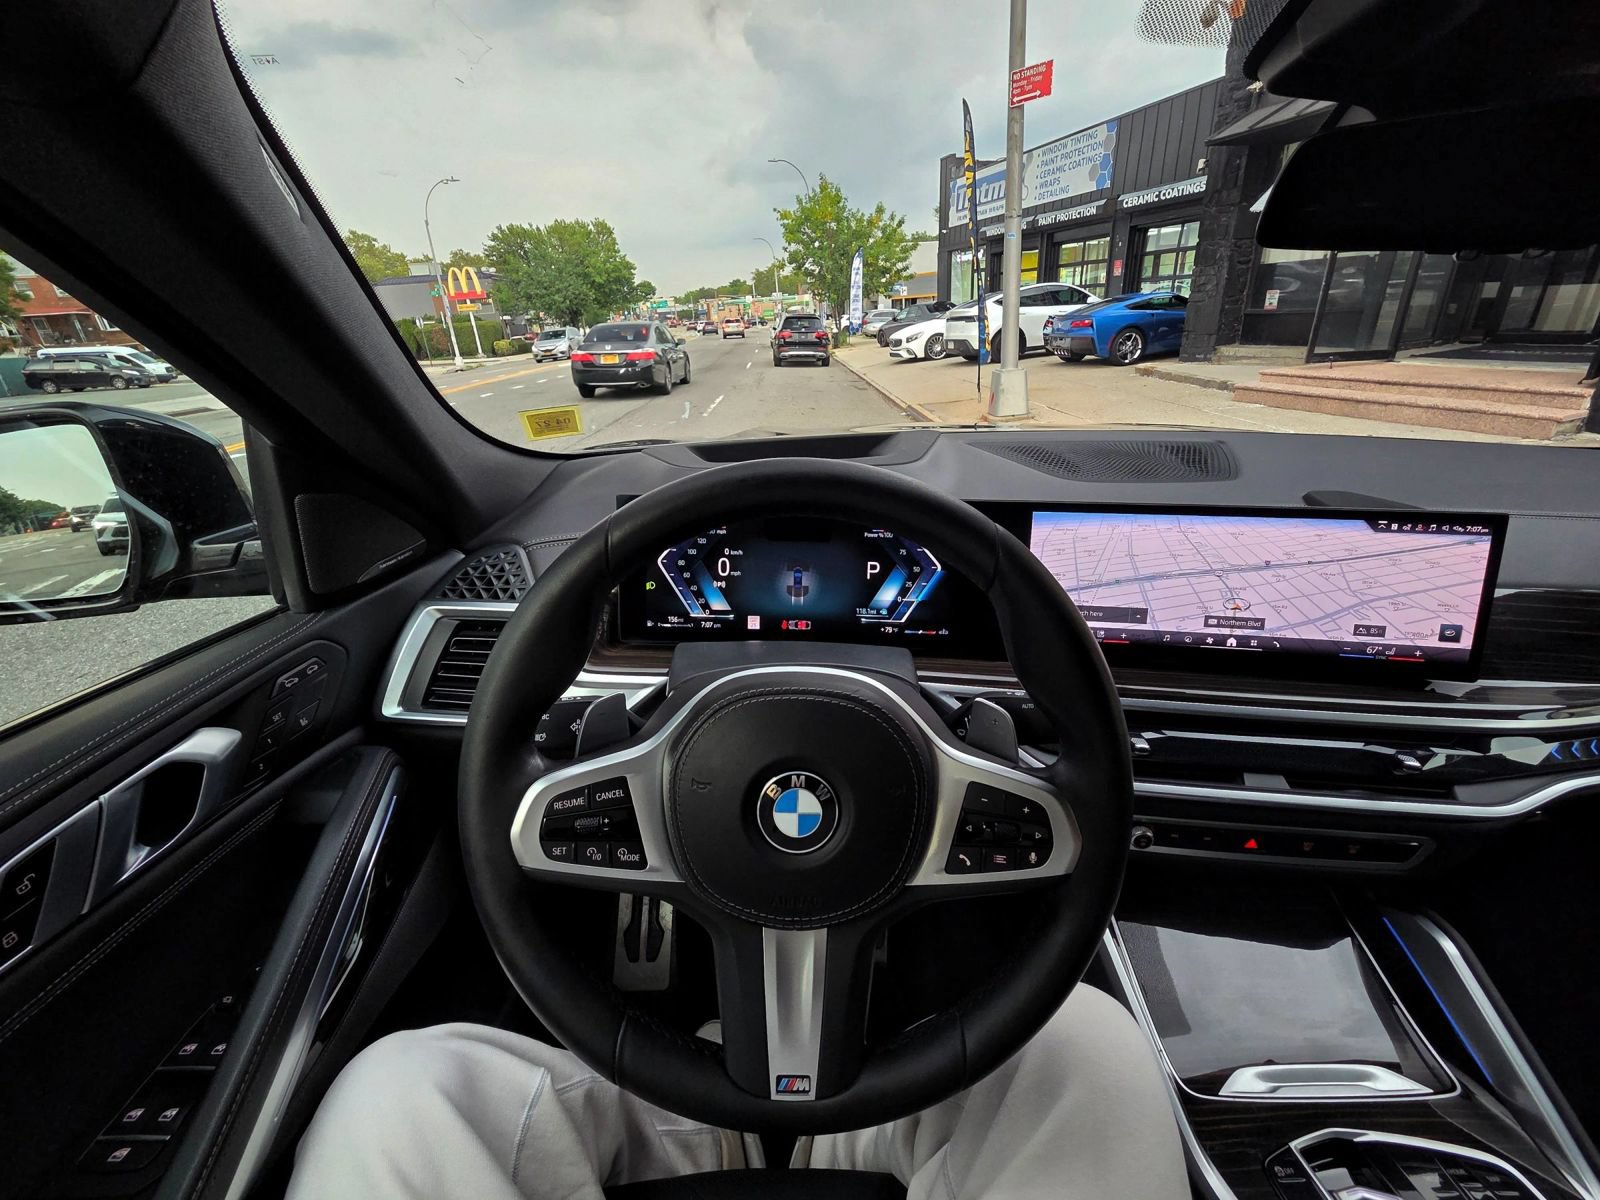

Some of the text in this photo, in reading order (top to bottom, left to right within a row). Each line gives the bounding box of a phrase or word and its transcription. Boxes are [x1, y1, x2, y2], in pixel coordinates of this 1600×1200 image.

[1013, 64, 1046, 80] NO STANDING
[1042, 130, 1098, 158] WINDOW TINTING
[1040, 140, 1104, 168] PAINT PROTECTION
[1040, 152, 1102, 180] CERAMIC COATINGS
[1039, 176, 1061, 190] WRAPS
[1038, 184, 1070, 200] DETAILING
[1123, 180, 1206, 208] CERAMIC COATINGS
[1038, 214, 1056, 226] PAINT
[1056, 206, 1096, 223] PROTECTION
[718, 557, 730, 576] 0
[867, 561, 880, 580] P
[272, 712, 282, 722] SET
[596, 789, 624, 801] CANCEL
[766, 775, 830, 800] BMW
[553, 796, 585, 810] RESUME
[552, 847, 567, 856] SET
[620, 853, 640, 862] MODE
